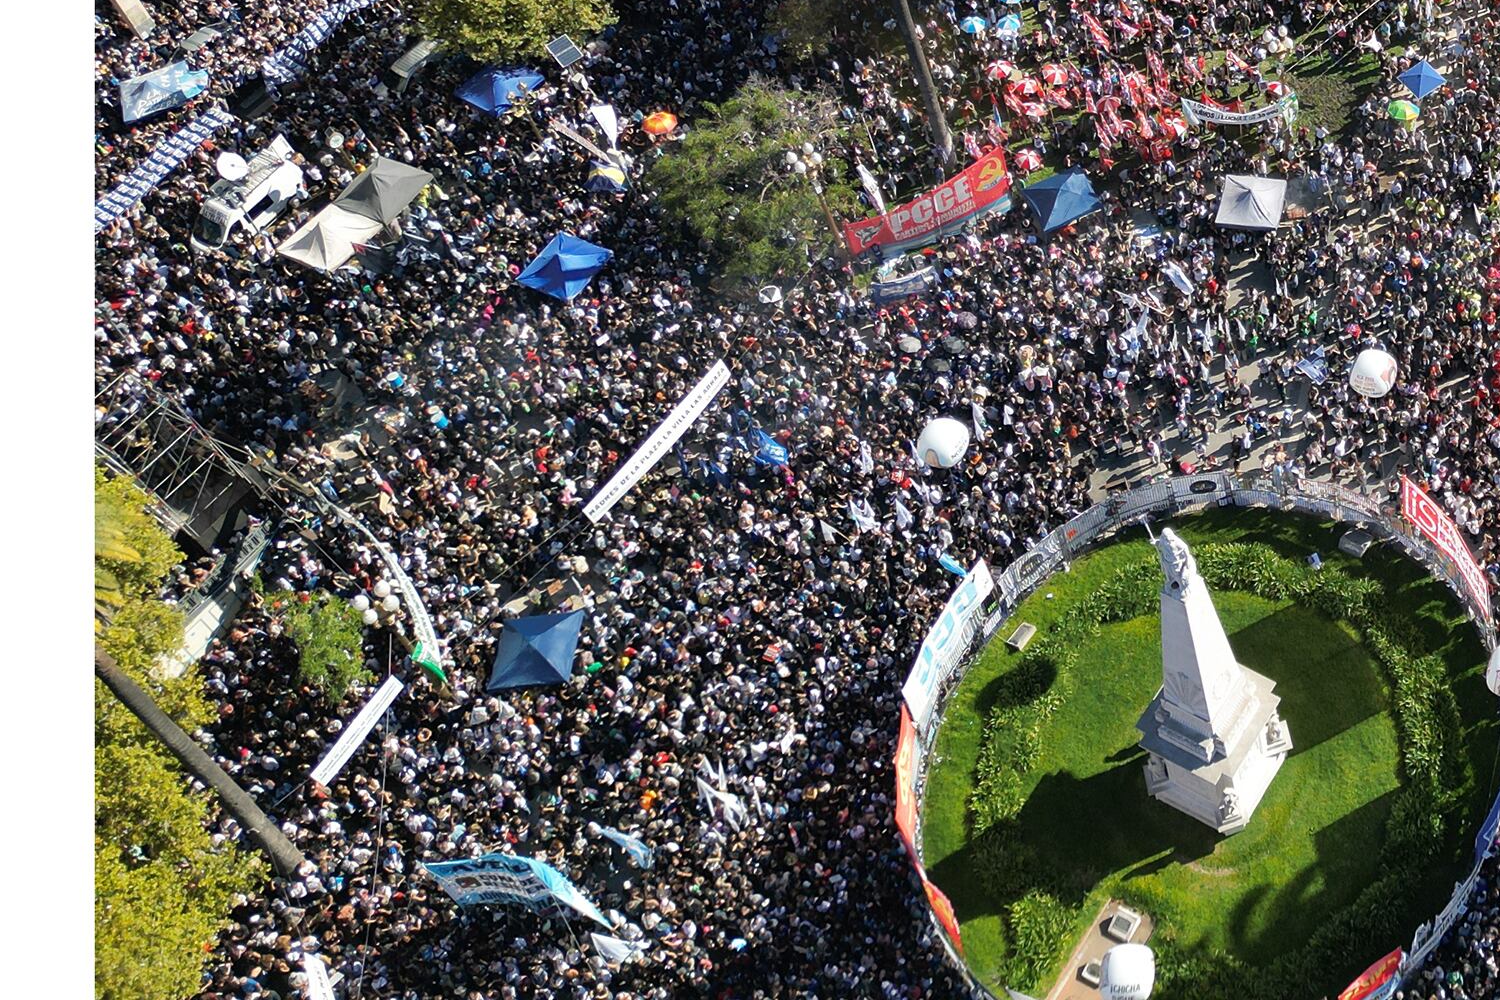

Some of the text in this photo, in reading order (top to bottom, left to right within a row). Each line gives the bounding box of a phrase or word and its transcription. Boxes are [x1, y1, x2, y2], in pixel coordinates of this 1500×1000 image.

[890, 176, 970, 233] PCCE
[588, 486, 619, 516] MADRES
[620, 474, 631, 485] DE
[631, 463, 640, 473] LA
[641, 440, 662, 465] PLAZA
